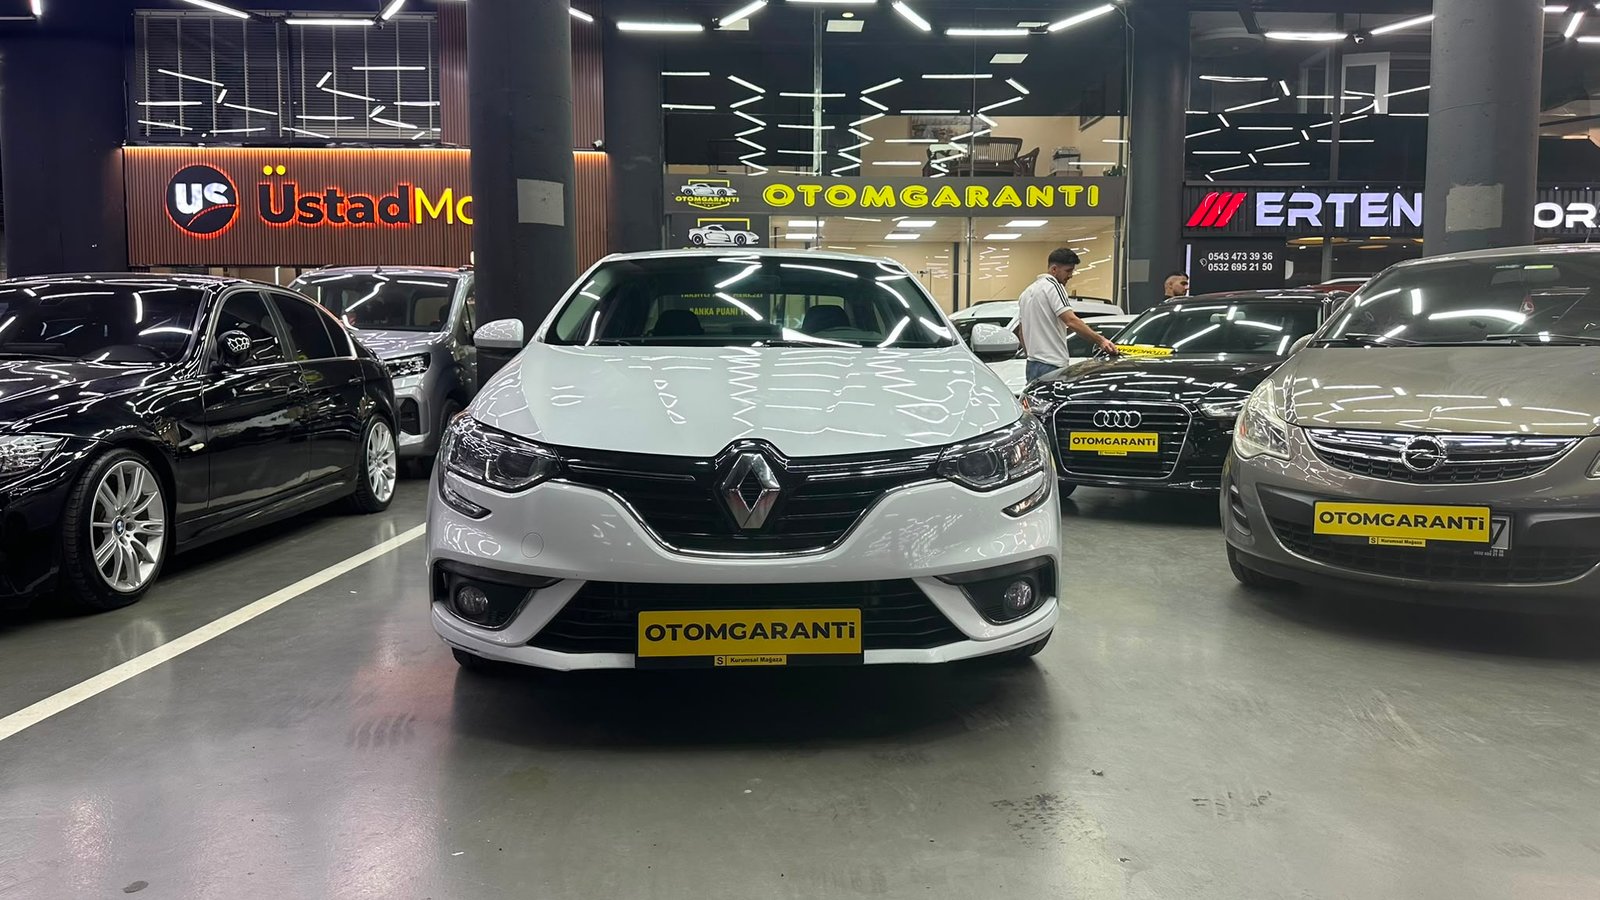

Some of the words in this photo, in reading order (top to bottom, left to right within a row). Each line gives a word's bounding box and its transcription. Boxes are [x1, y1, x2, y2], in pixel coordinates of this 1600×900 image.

[762, 183, 1099, 208] OTOMGARANTI
[1255, 192, 1422, 228] ERTEN
[1533, 202, 1600, 228] OR
[1208, 252, 1229, 261] 0543
[1231, 252, 1247, 261] 473
[1249, 252, 1260, 260] 39
[1262, 252, 1273, 260] 36
[1208, 263, 1229, 271] 0532
[1231, 263, 1247, 271] 695
[1249, 263, 1259, 271] 21
[1262, 262, 1273, 271] 50
[717, 656, 724, 665] S
[760, 656, 783, 664] Mağaza
